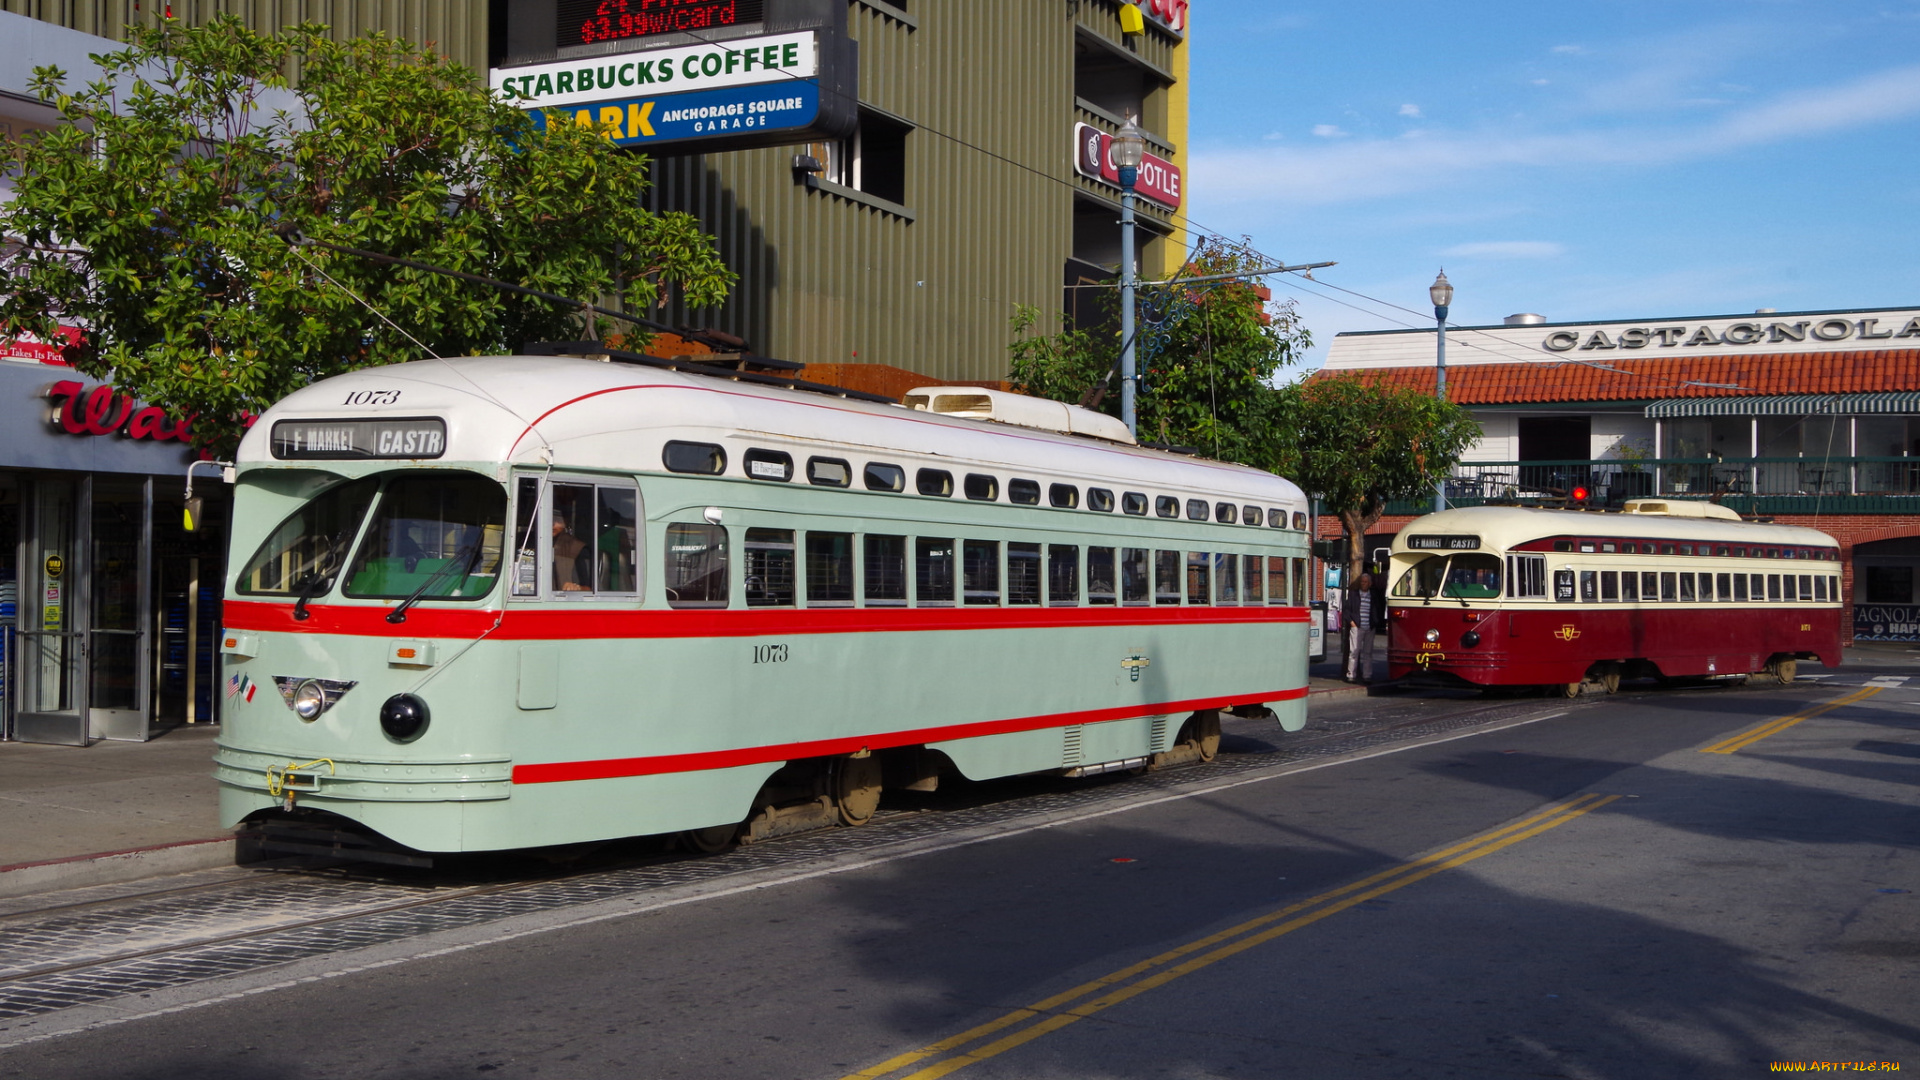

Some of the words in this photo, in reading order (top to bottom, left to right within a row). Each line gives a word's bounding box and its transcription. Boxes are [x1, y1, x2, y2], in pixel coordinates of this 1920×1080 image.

[502, 58, 674, 100] STARBUCKS
[682, 42, 799, 80] COFFEE
[662, 103, 744, 123] ANCHORAGE
[748, 97, 803, 114] SQUARE
[545, 101, 657, 146] ARK
[694, 115, 766, 132] GARAGE
[1107, 147, 1179, 198] CPOTLE
[10, 347, 33, 358] Takes
[34, 350, 45, 359] Its
[341, 390, 402, 406] 1073
[294, 428, 302, 452] F
[307, 427, 355, 451] MARKET
[379, 429, 444, 454] CASTR
[1451, 539, 1479, 549] CASTR
[1889, 622, 1920, 634] HAP
[752, 643, 789, 664] 1073
